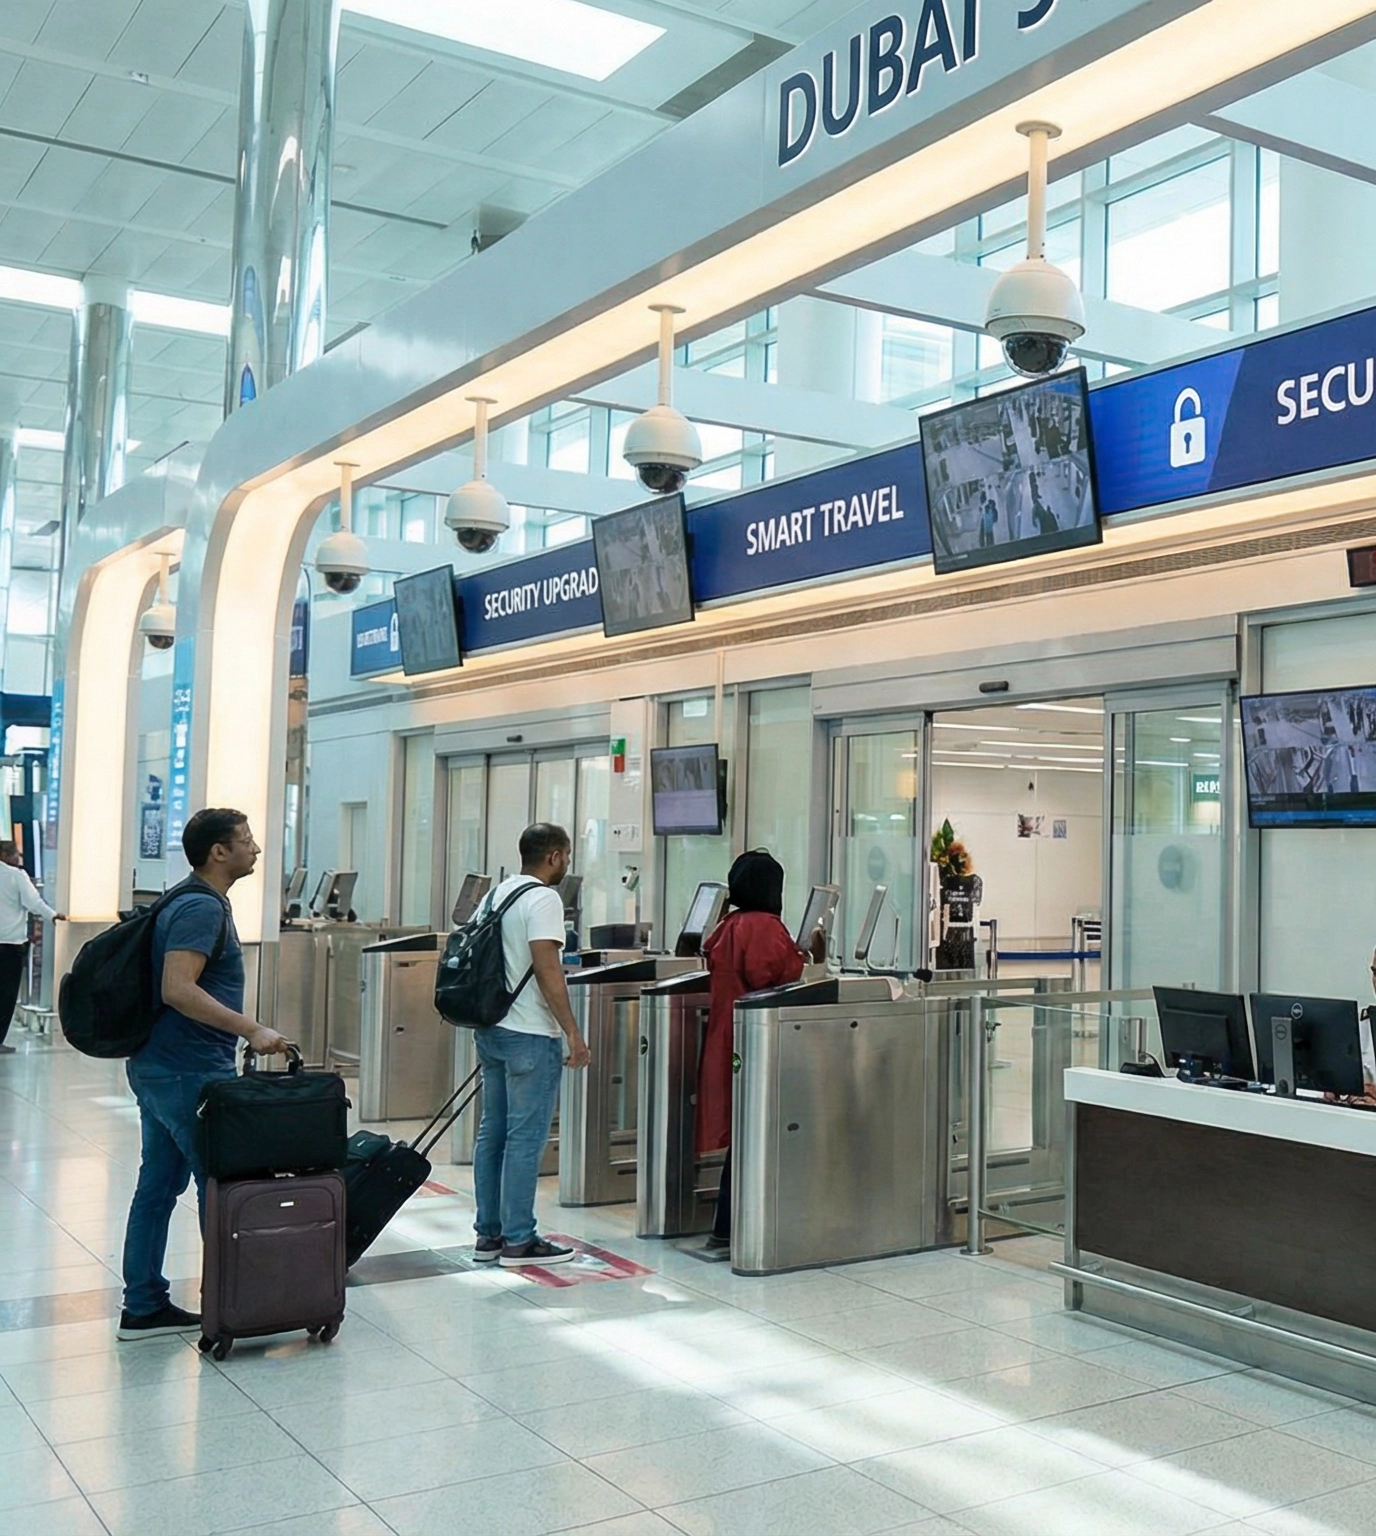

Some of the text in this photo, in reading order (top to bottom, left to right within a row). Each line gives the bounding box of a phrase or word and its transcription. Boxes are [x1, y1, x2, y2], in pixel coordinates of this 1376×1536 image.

[778, 0, 979, 167] DUBAI
[746, 484, 904, 556] SMART TRAVEL
[484, 566, 599, 620] SECURITY UPGRAD
